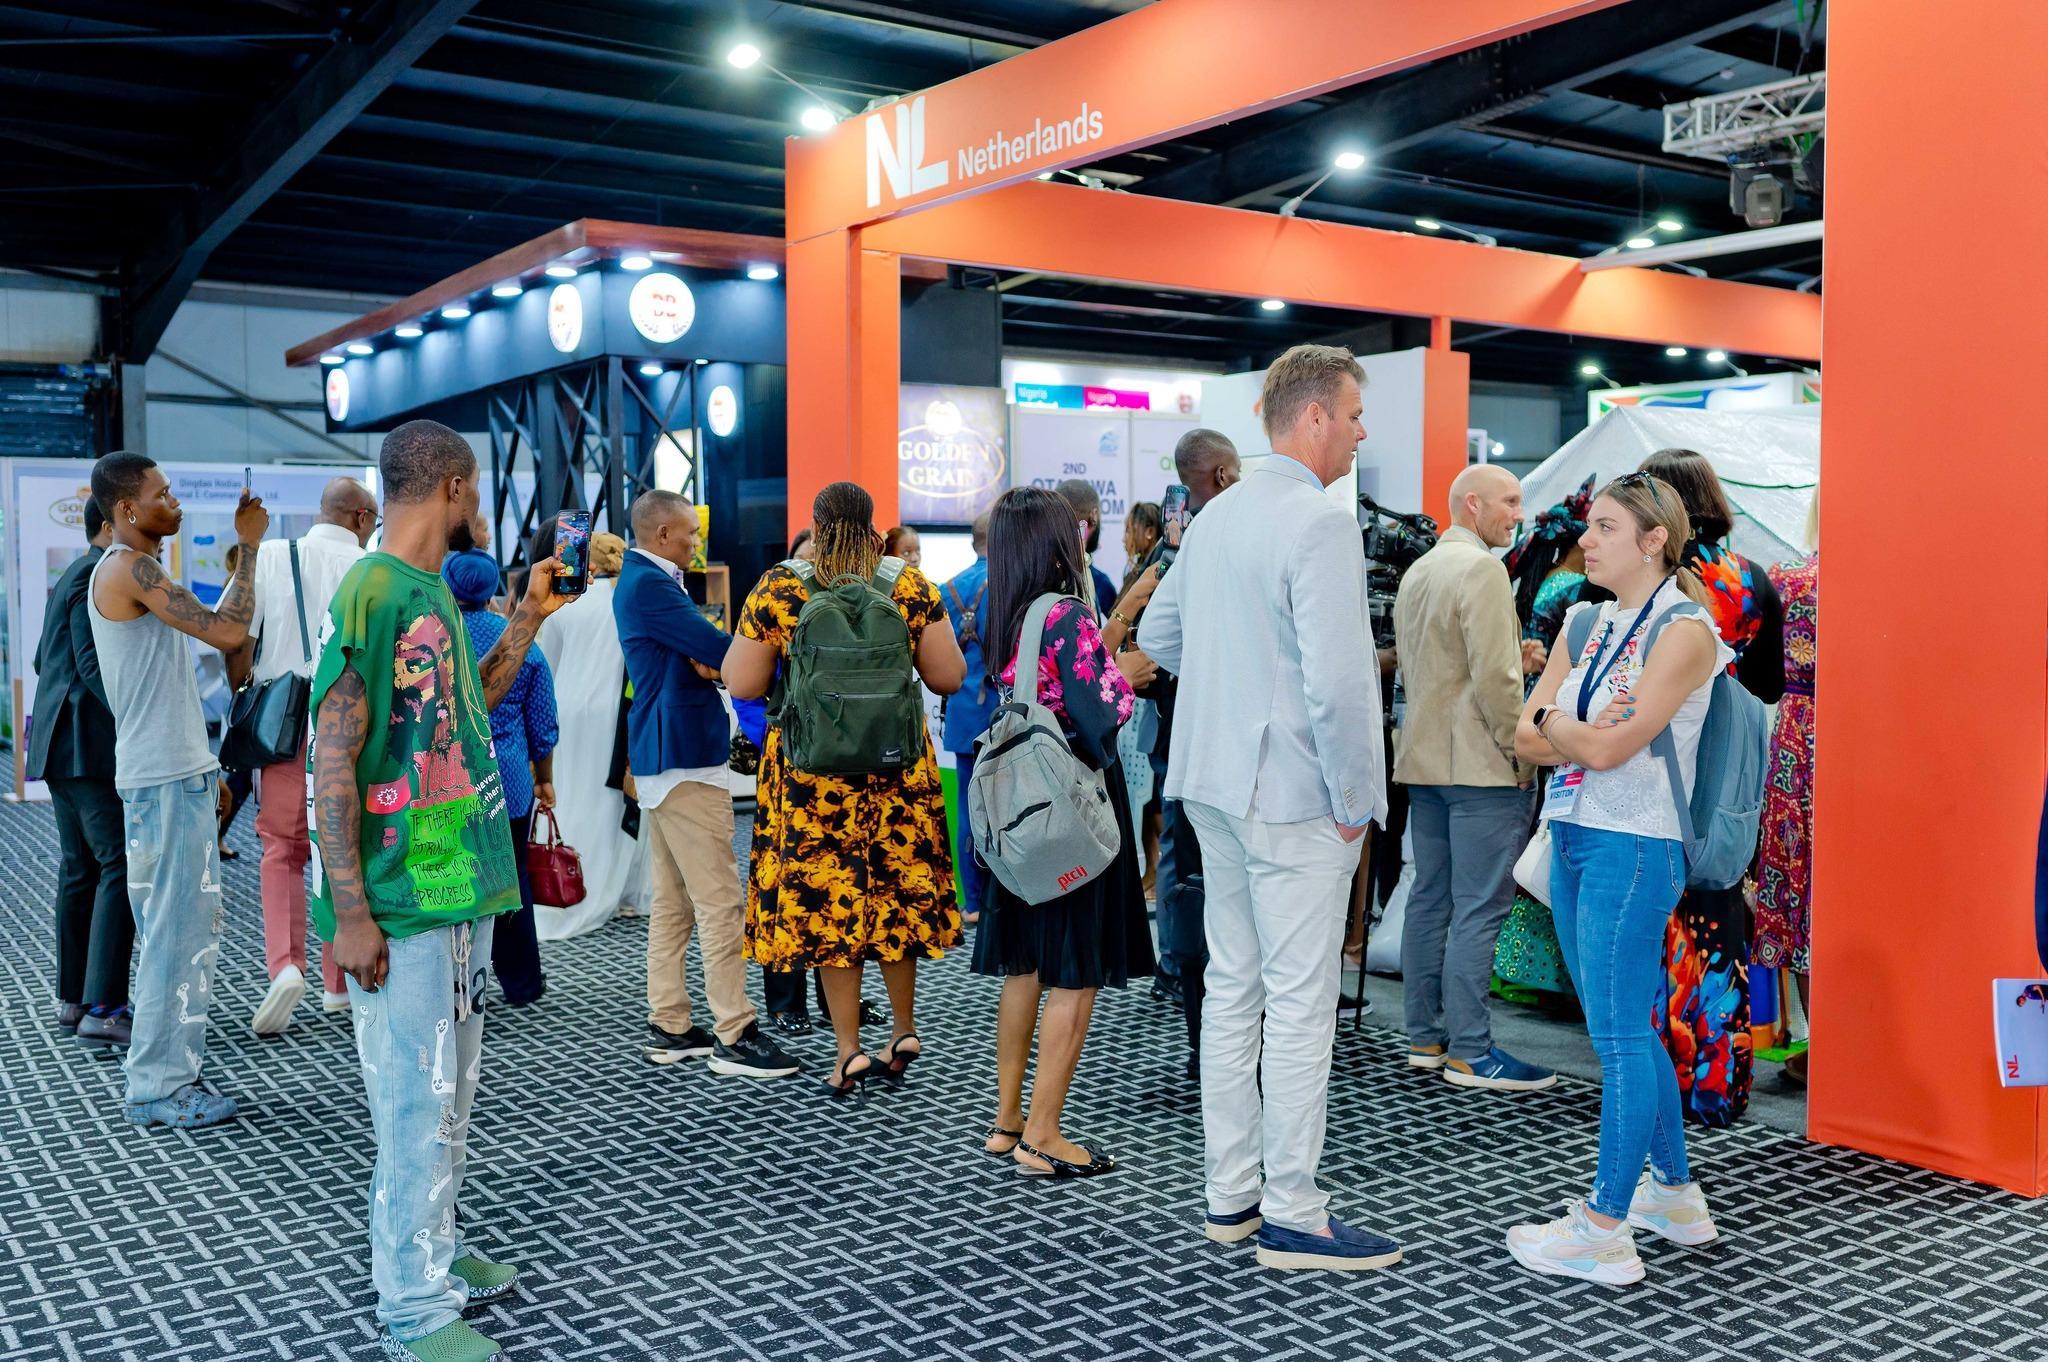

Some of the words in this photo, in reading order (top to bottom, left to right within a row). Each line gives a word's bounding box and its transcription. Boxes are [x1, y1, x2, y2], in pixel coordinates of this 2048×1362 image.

[866, 96, 948, 208] NL
[958, 102, 1103, 180] Netherlands
[1063, 463, 1086, 475] 2ND
[475, 772, 496, 794] Never
[410, 813, 421, 841] IF
[425, 807, 455, 831] THERE
[411, 862, 451, 880] THERE
[417, 883, 473, 906] PROGRESS
[2007, 1055, 2020, 1079] NL
